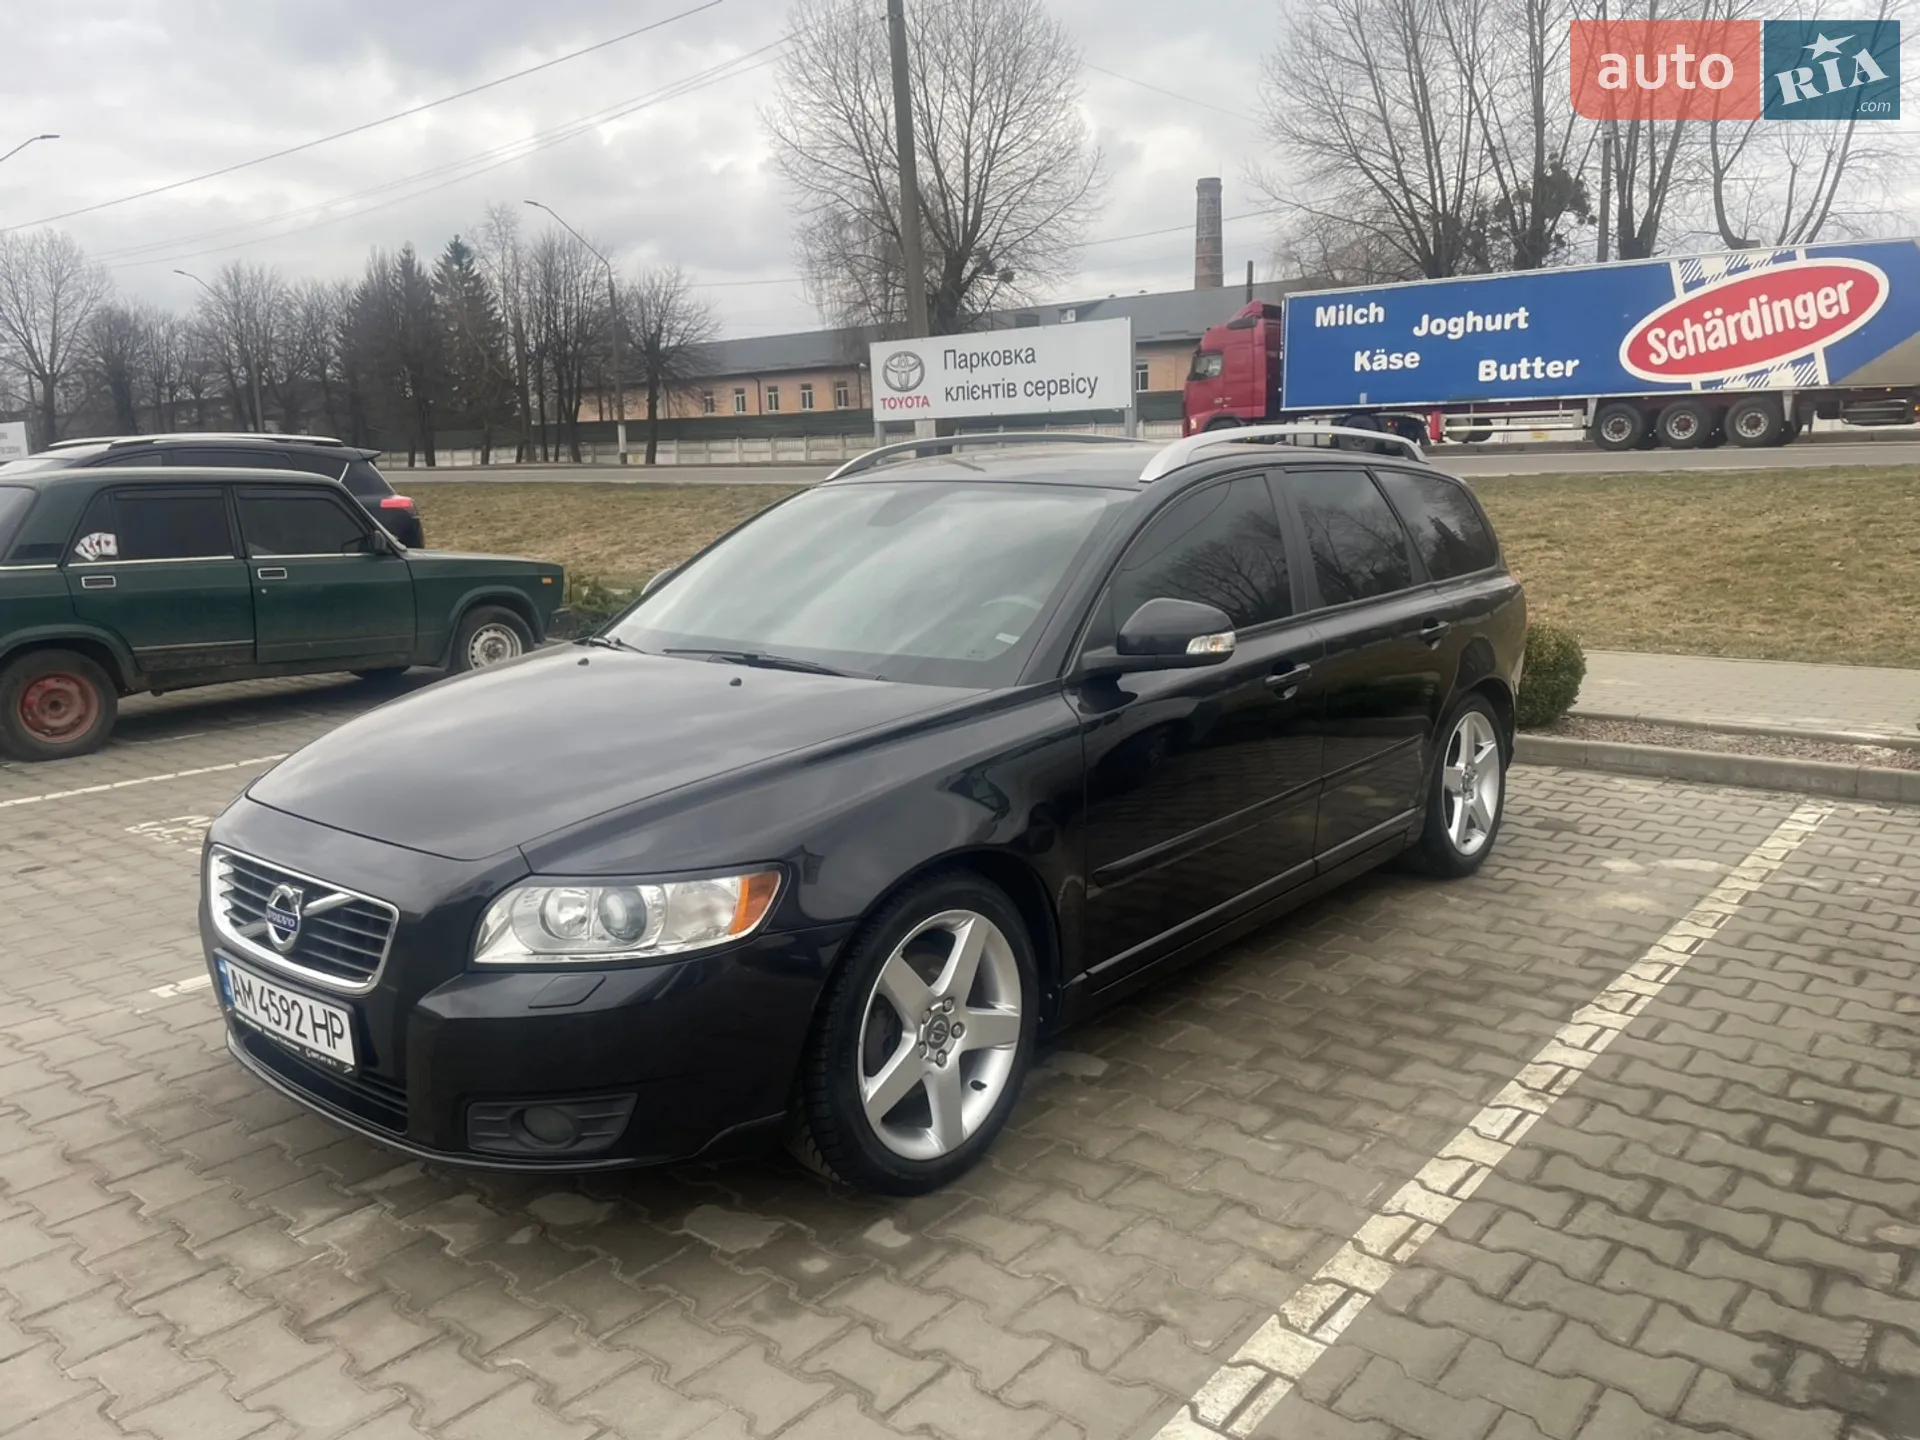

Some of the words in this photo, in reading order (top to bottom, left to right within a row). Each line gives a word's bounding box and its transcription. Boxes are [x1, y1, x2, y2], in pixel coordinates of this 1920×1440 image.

[1315, 302, 1385, 328] Milch
[1413, 306, 1530, 340] Joghurt
[1647, 280, 1855, 366] Schärdinger
[943, 346, 1037, 374] Парковка
[1354, 348, 1421, 373] Käse
[1478, 356, 1580, 383] Butter
[880, 395, 931, 411] TOYOTA
[945, 378, 1018, 402] клієнтів
[1023, 372, 1099, 402] сервісу
[267, 909, 297, 928] VOLVO
[230, 969, 258, 1016] AM
[259, 985, 308, 1040] 4592
[309, 1005, 345, 1051] HP
